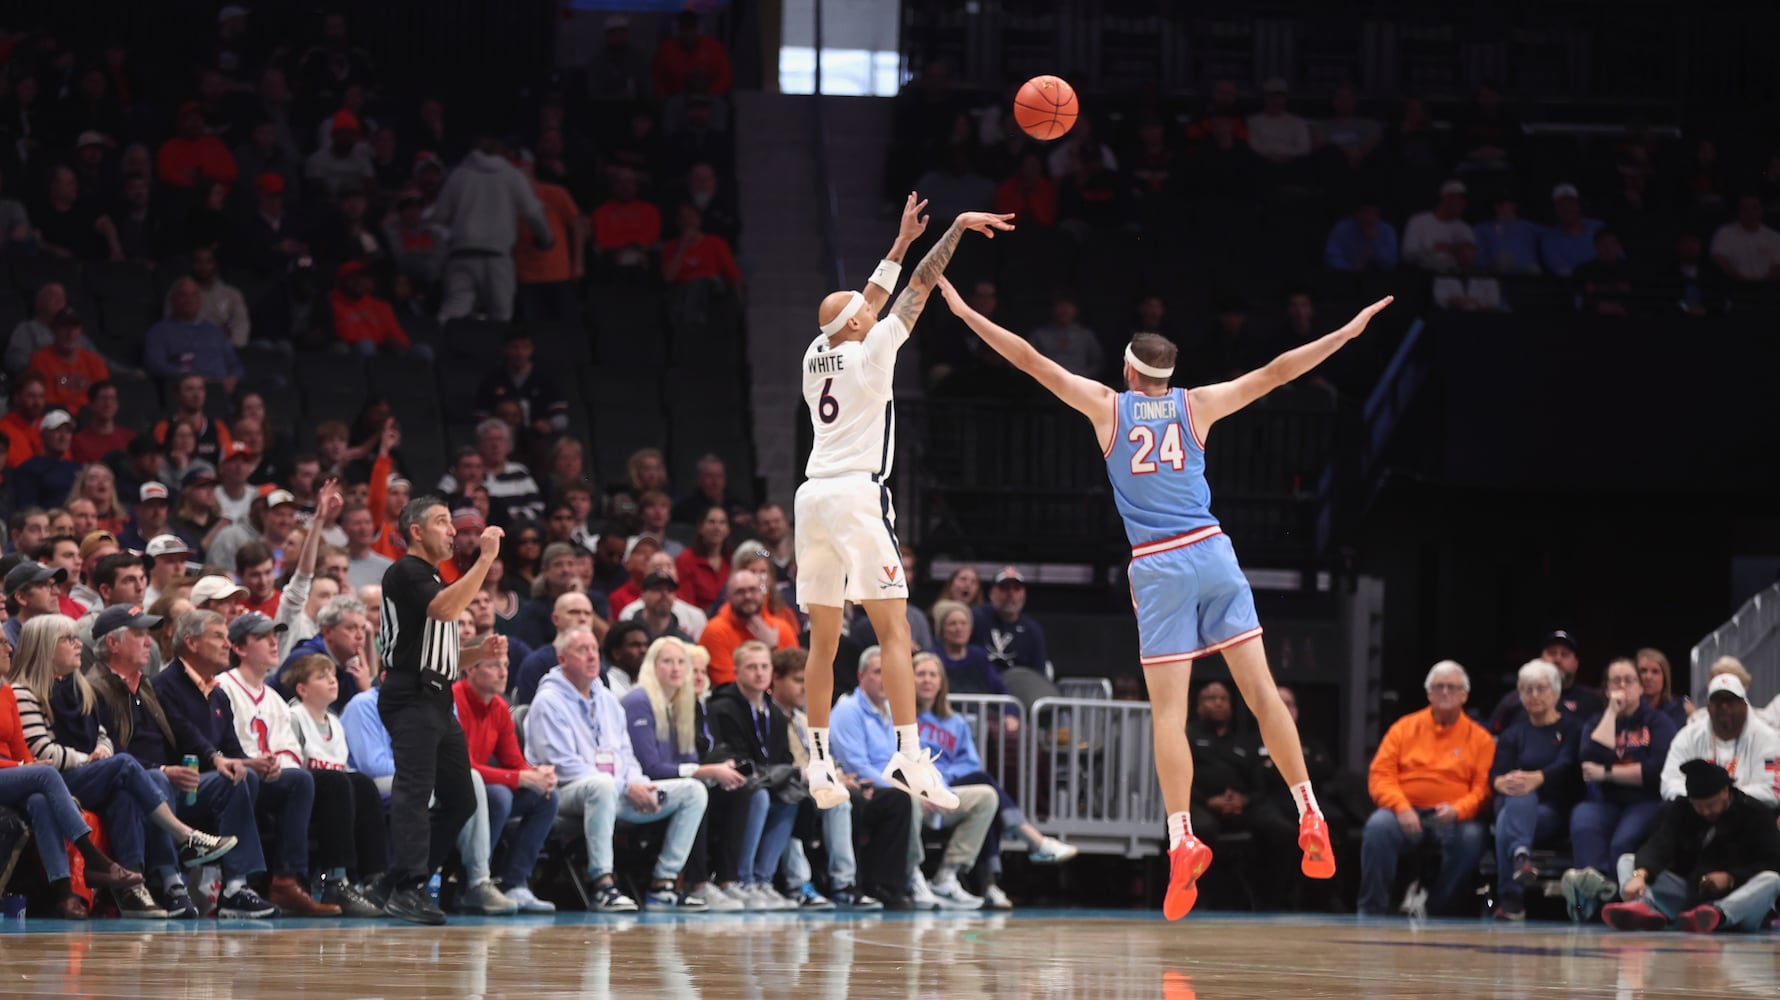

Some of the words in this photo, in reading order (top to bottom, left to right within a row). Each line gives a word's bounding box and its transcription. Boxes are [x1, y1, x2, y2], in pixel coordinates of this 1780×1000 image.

[808, 354, 844, 374] WHITE
[818, 377, 839, 424] 6
[1133, 400, 1177, 420] CONNER
[1128, 422, 1186, 475] 24
[883, 565, 898, 582] V
